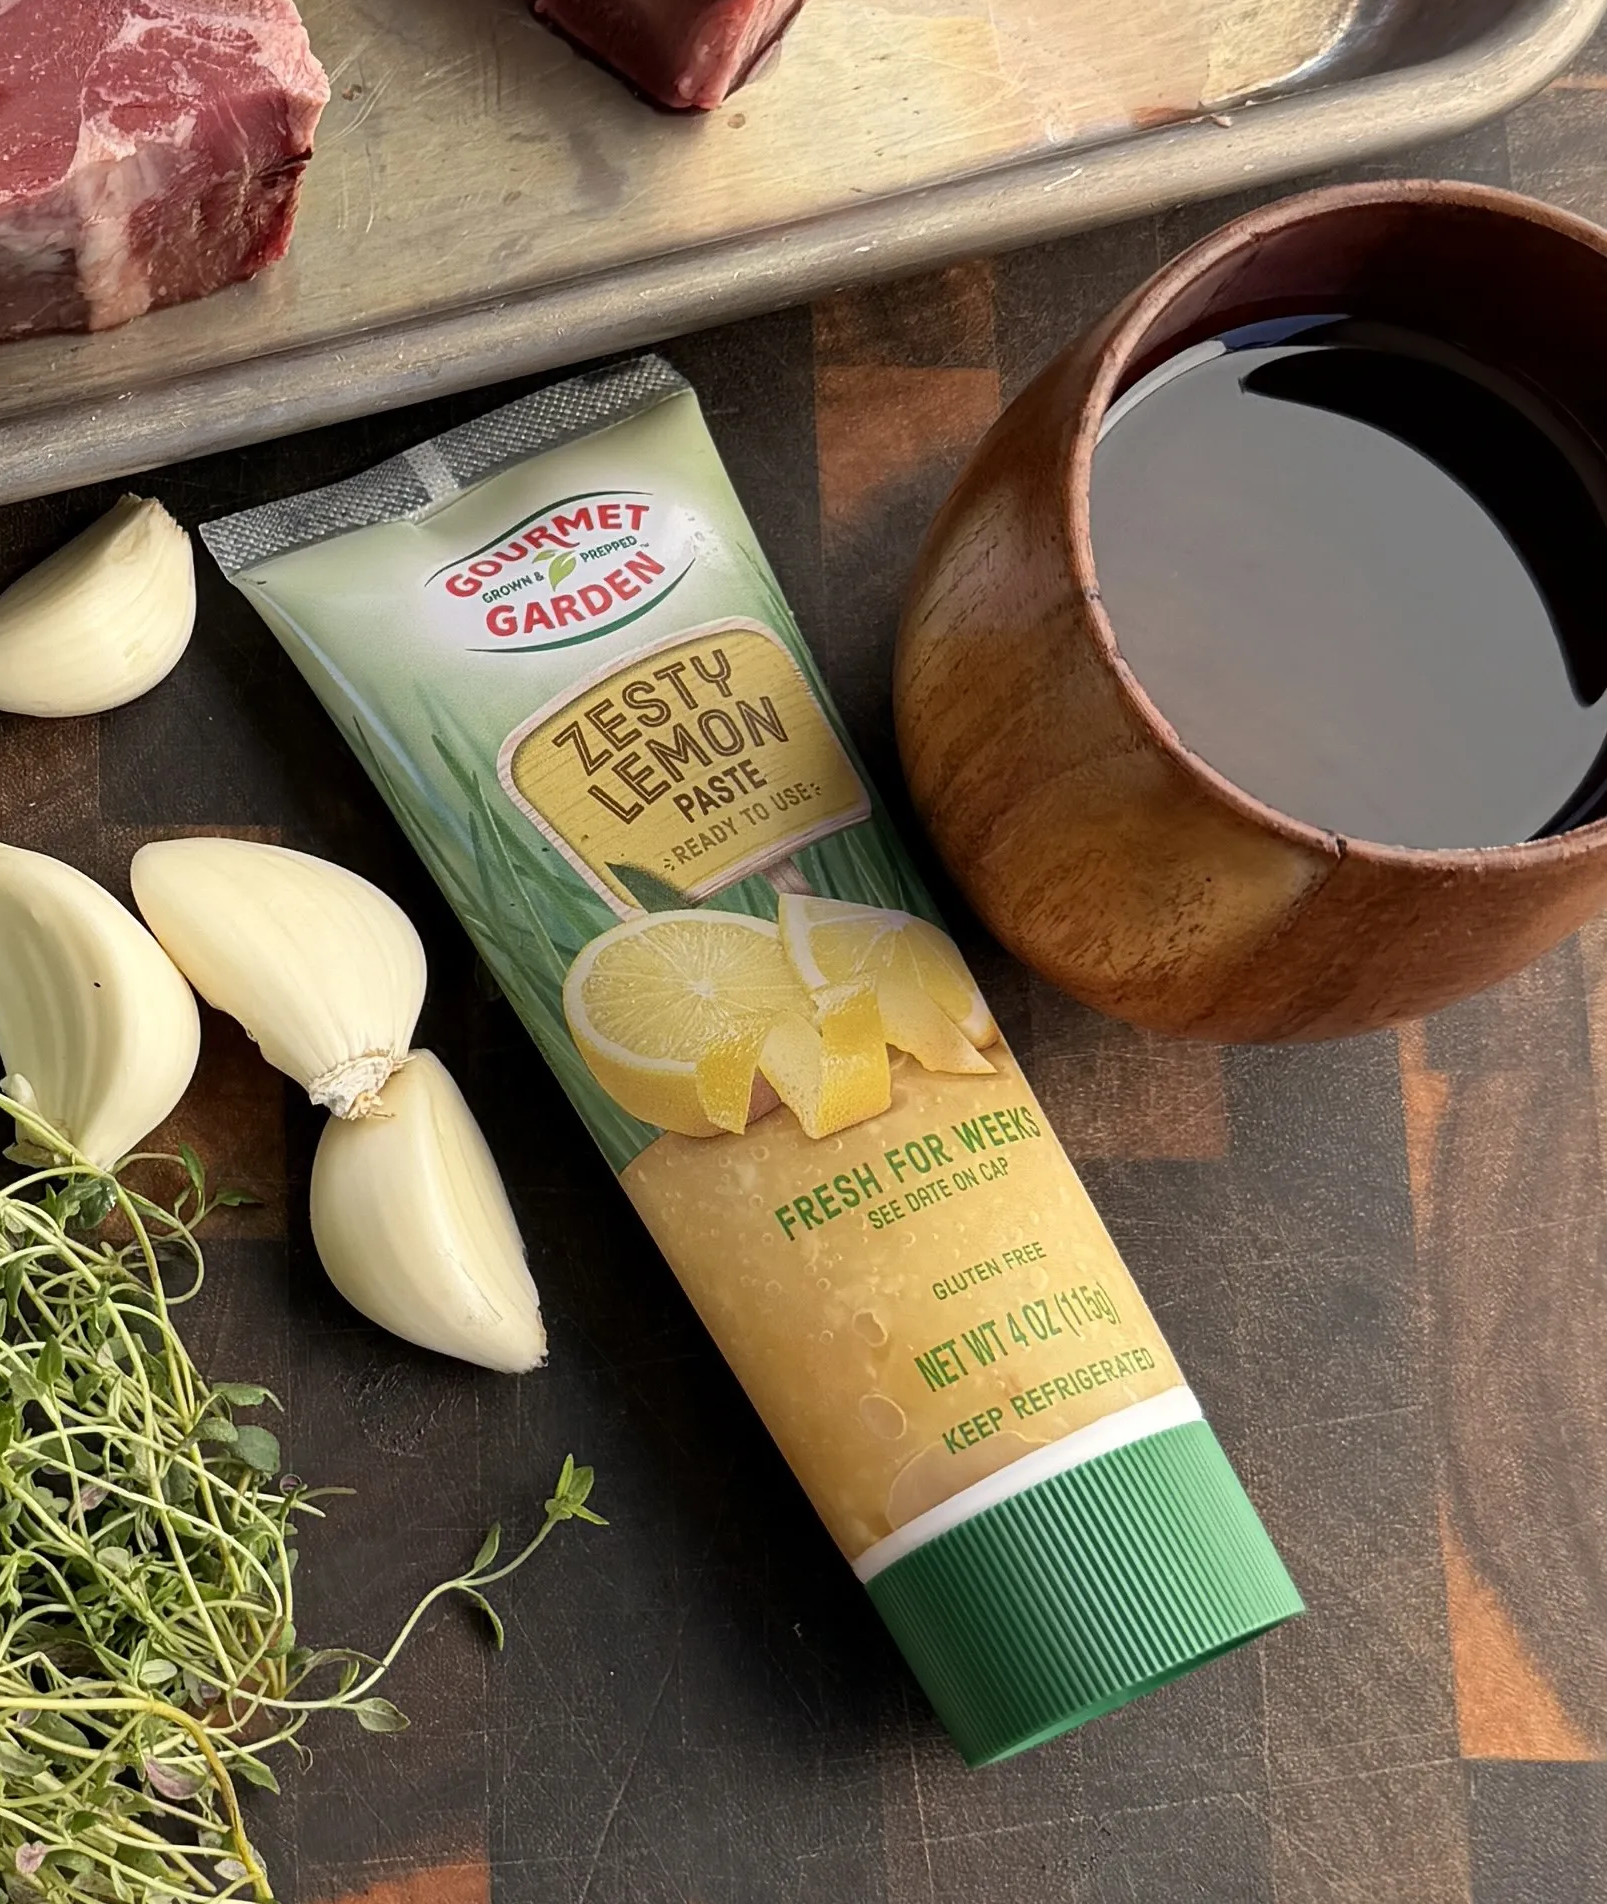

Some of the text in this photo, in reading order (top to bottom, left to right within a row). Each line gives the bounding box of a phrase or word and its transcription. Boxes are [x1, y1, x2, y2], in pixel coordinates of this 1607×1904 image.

[445, 504, 650, 597] GOURMET
[482, 535, 637, 604] GROWN & PREPPED
[486, 550, 666, 637] GARDEN
[552, 649, 732, 776] ZESTY
[587, 696, 789, 825] LEMON
[672, 759, 767, 823] PASTE
[671, 783, 812, 865] READY TO USE
[774, 1106, 1042, 1241] FRESH FOR WEEKS
[867, 1157, 1009, 1230] SEE DATE ON CAP
[932, 1242, 1047, 1300] GLUTEN FREE
[914, 1281, 1122, 1392] NET WT 4 OZ (115g)
[942, 1347, 1155, 1454] KEEP REFRIGERATED
